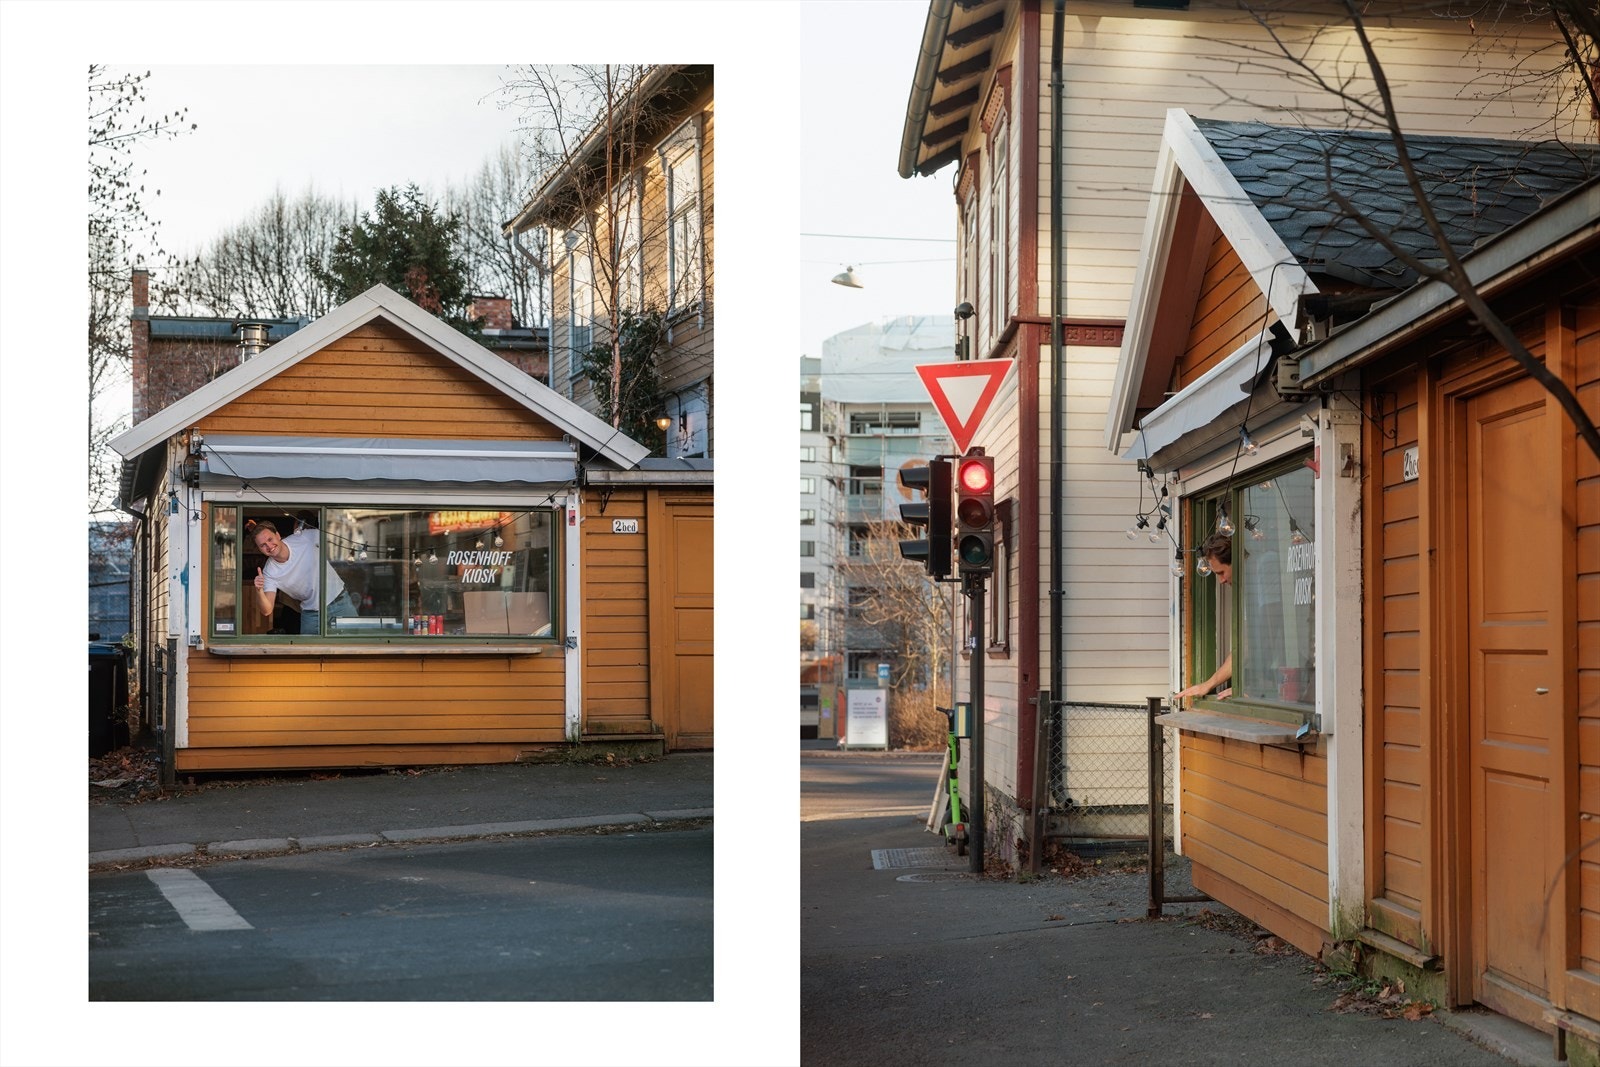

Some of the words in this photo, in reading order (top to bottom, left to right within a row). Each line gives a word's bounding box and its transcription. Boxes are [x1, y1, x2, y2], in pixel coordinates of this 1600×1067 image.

[615, 520, 636, 532] 2bcd
[446, 550, 512, 566] ROSENHOFF
[462, 568, 498, 584] KIOSK
[1293, 577, 1313, 605] KIOSK
